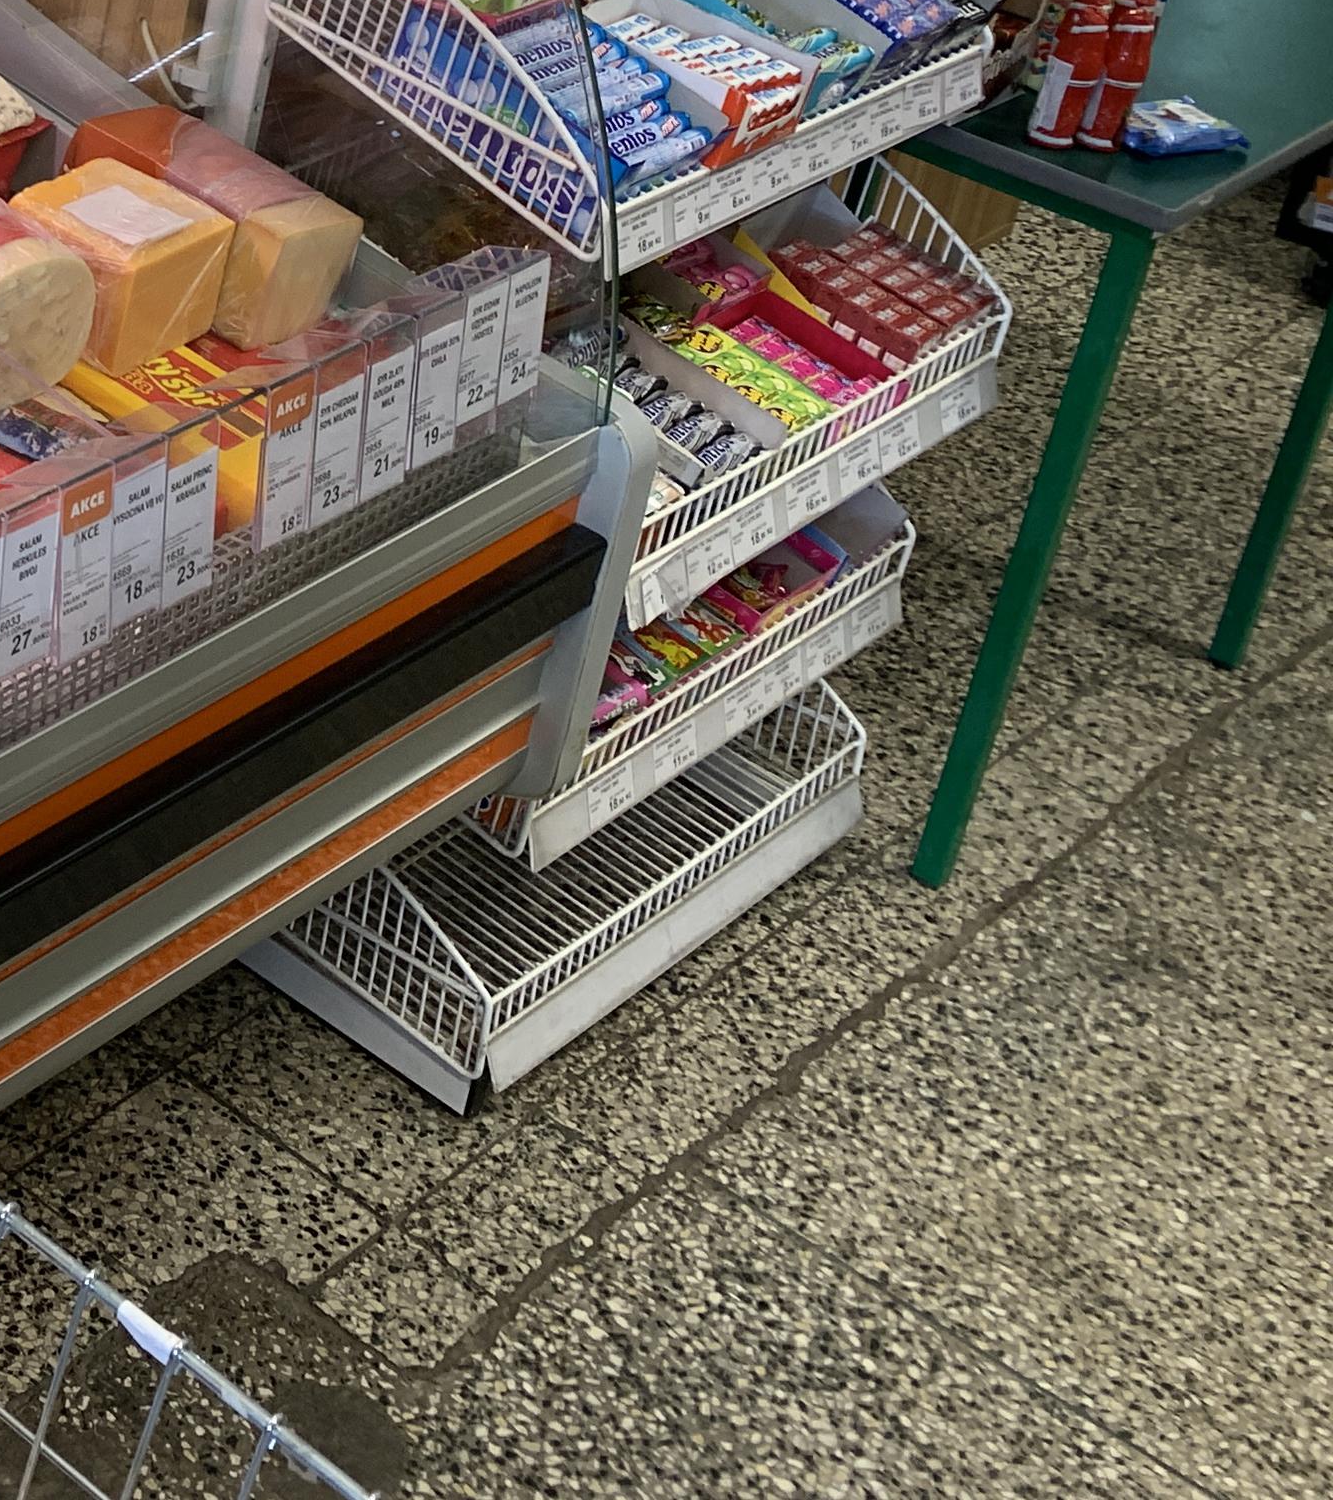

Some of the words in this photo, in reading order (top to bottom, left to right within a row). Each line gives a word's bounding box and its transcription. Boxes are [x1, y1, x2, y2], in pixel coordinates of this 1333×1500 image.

[609, 126, 656, 155] entos
[275, 393, 307, 419] AKCE
[71, 490, 105, 520] AKCE
